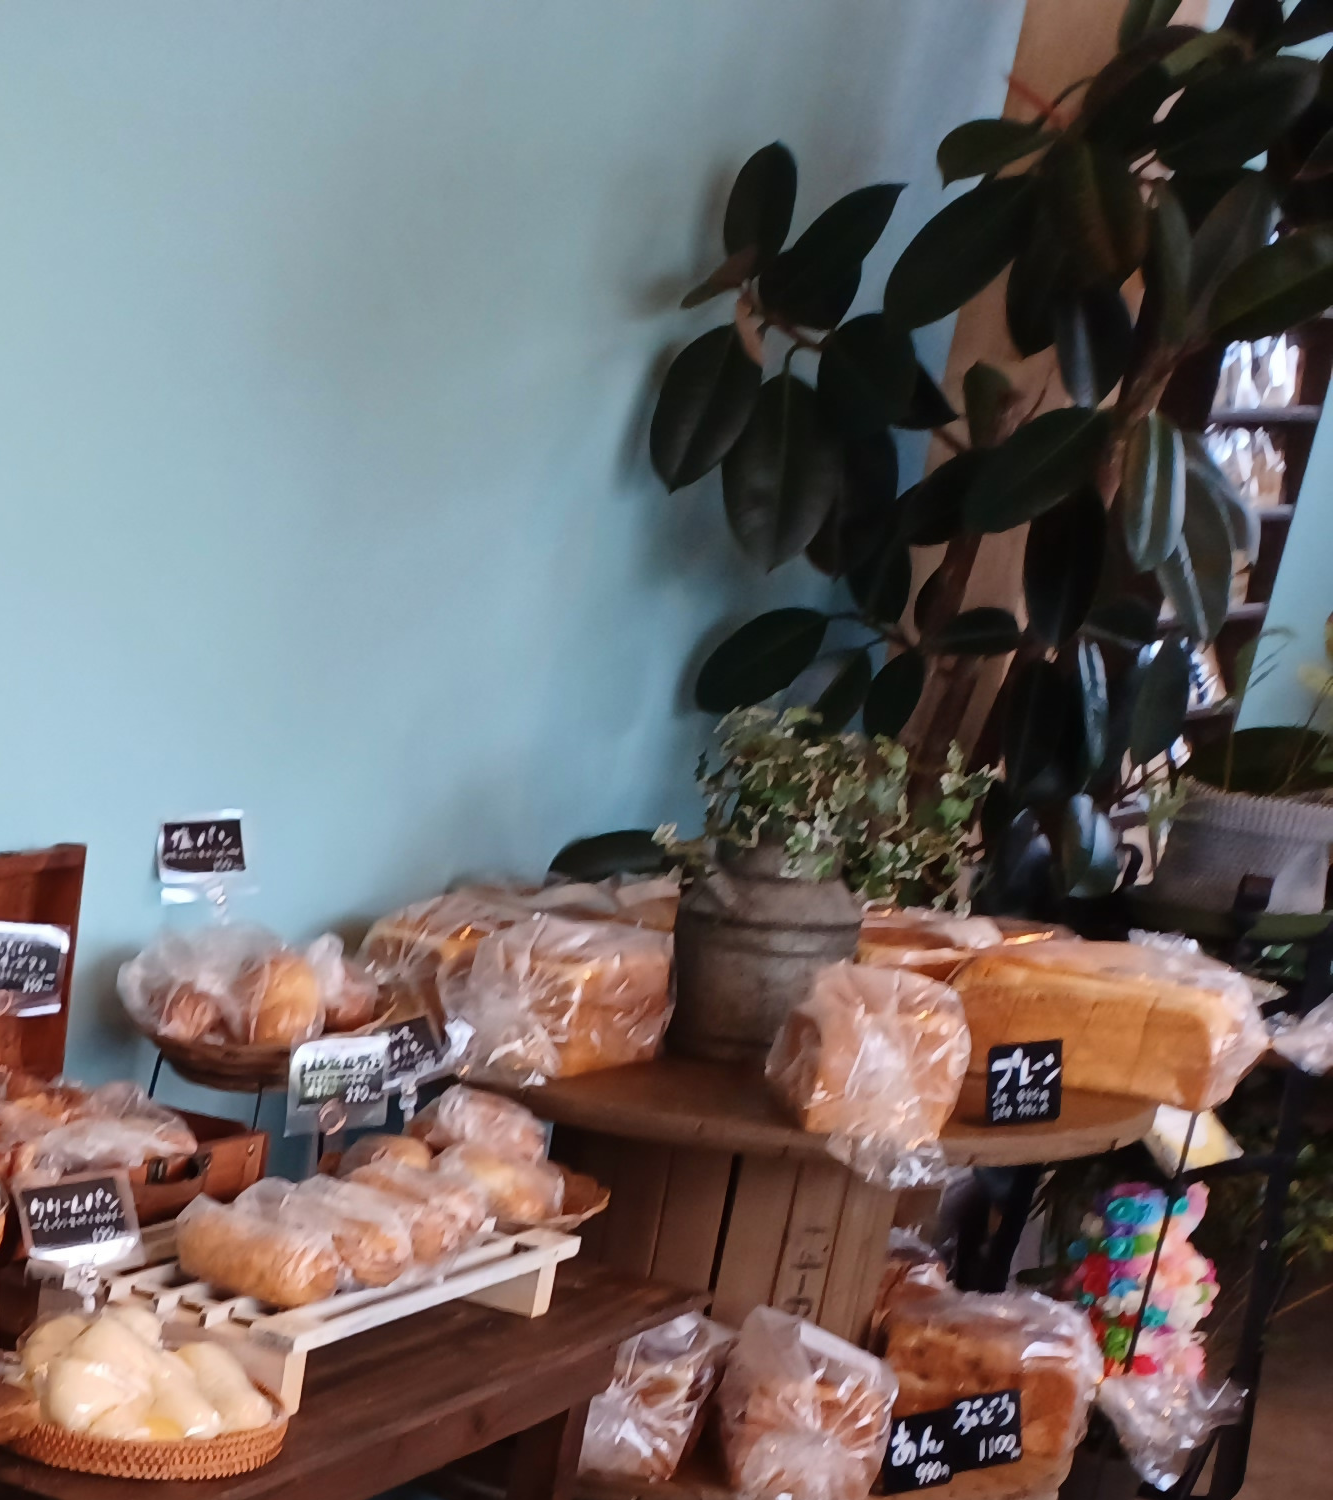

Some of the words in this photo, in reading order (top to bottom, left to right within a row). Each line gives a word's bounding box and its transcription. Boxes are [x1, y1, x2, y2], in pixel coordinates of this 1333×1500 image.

[991, 1047, 1061, 1099] プレーン
[30, 1187, 120, 1221] クリームパン
[953, 1393, 1016, 1436] ぶどう
[891, 1420, 945, 1467] あん
